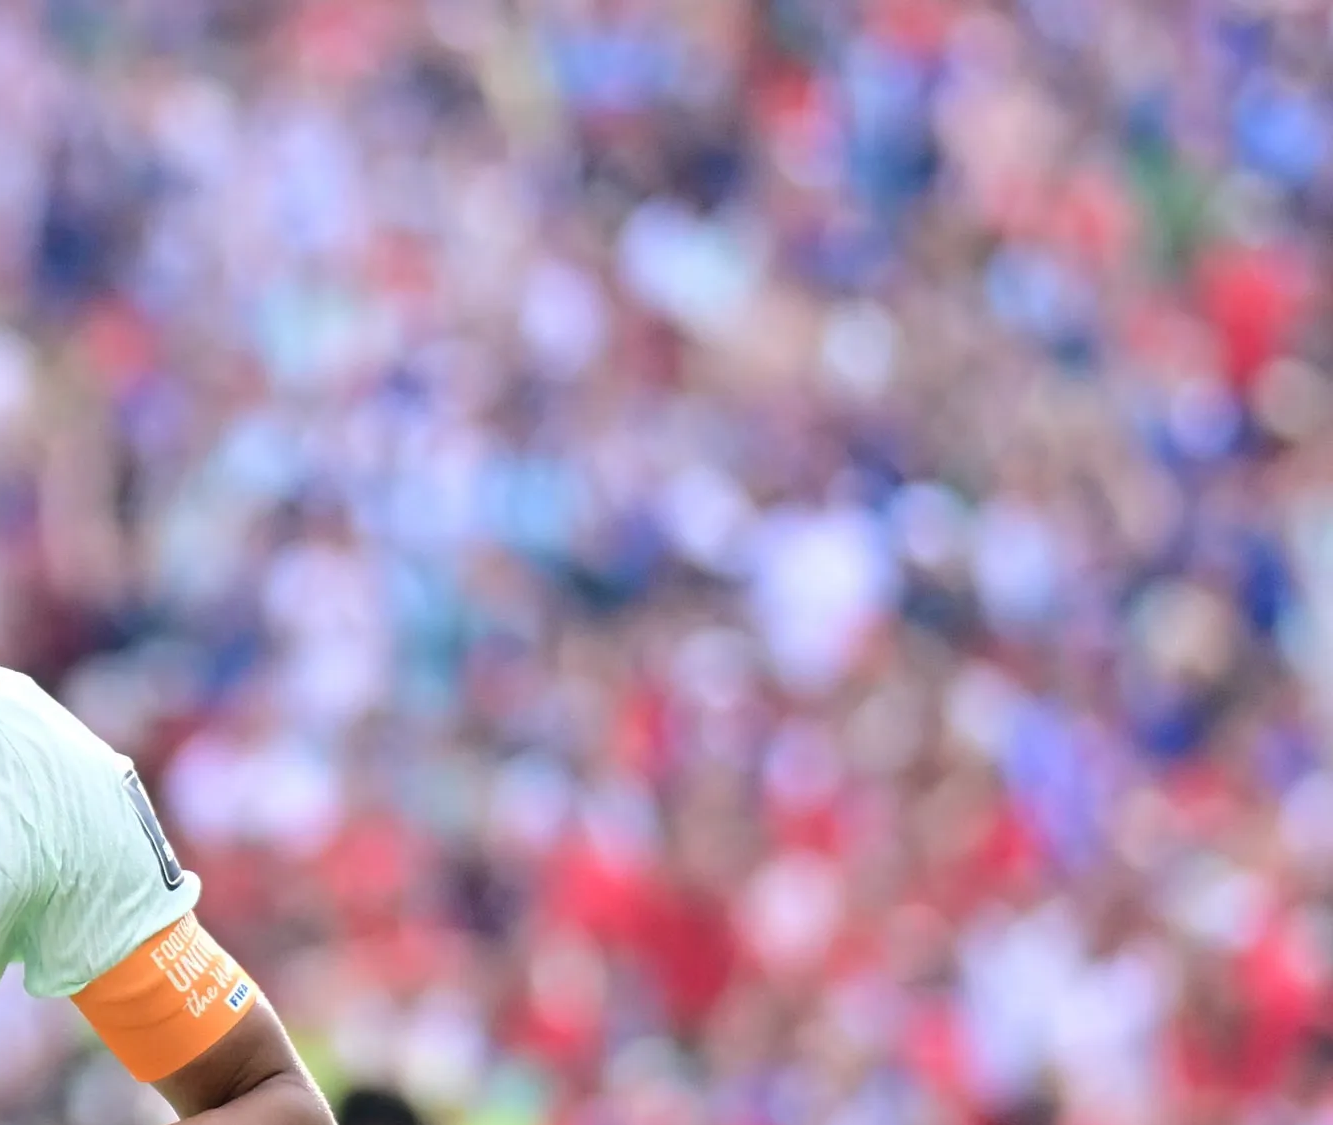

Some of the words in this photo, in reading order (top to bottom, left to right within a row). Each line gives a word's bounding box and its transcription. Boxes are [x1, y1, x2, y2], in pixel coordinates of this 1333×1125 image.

[165, 936, 215, 992] UNIT
[183, 986, 218, 1018] the
[229, 983, 249, 1008] FIFA
